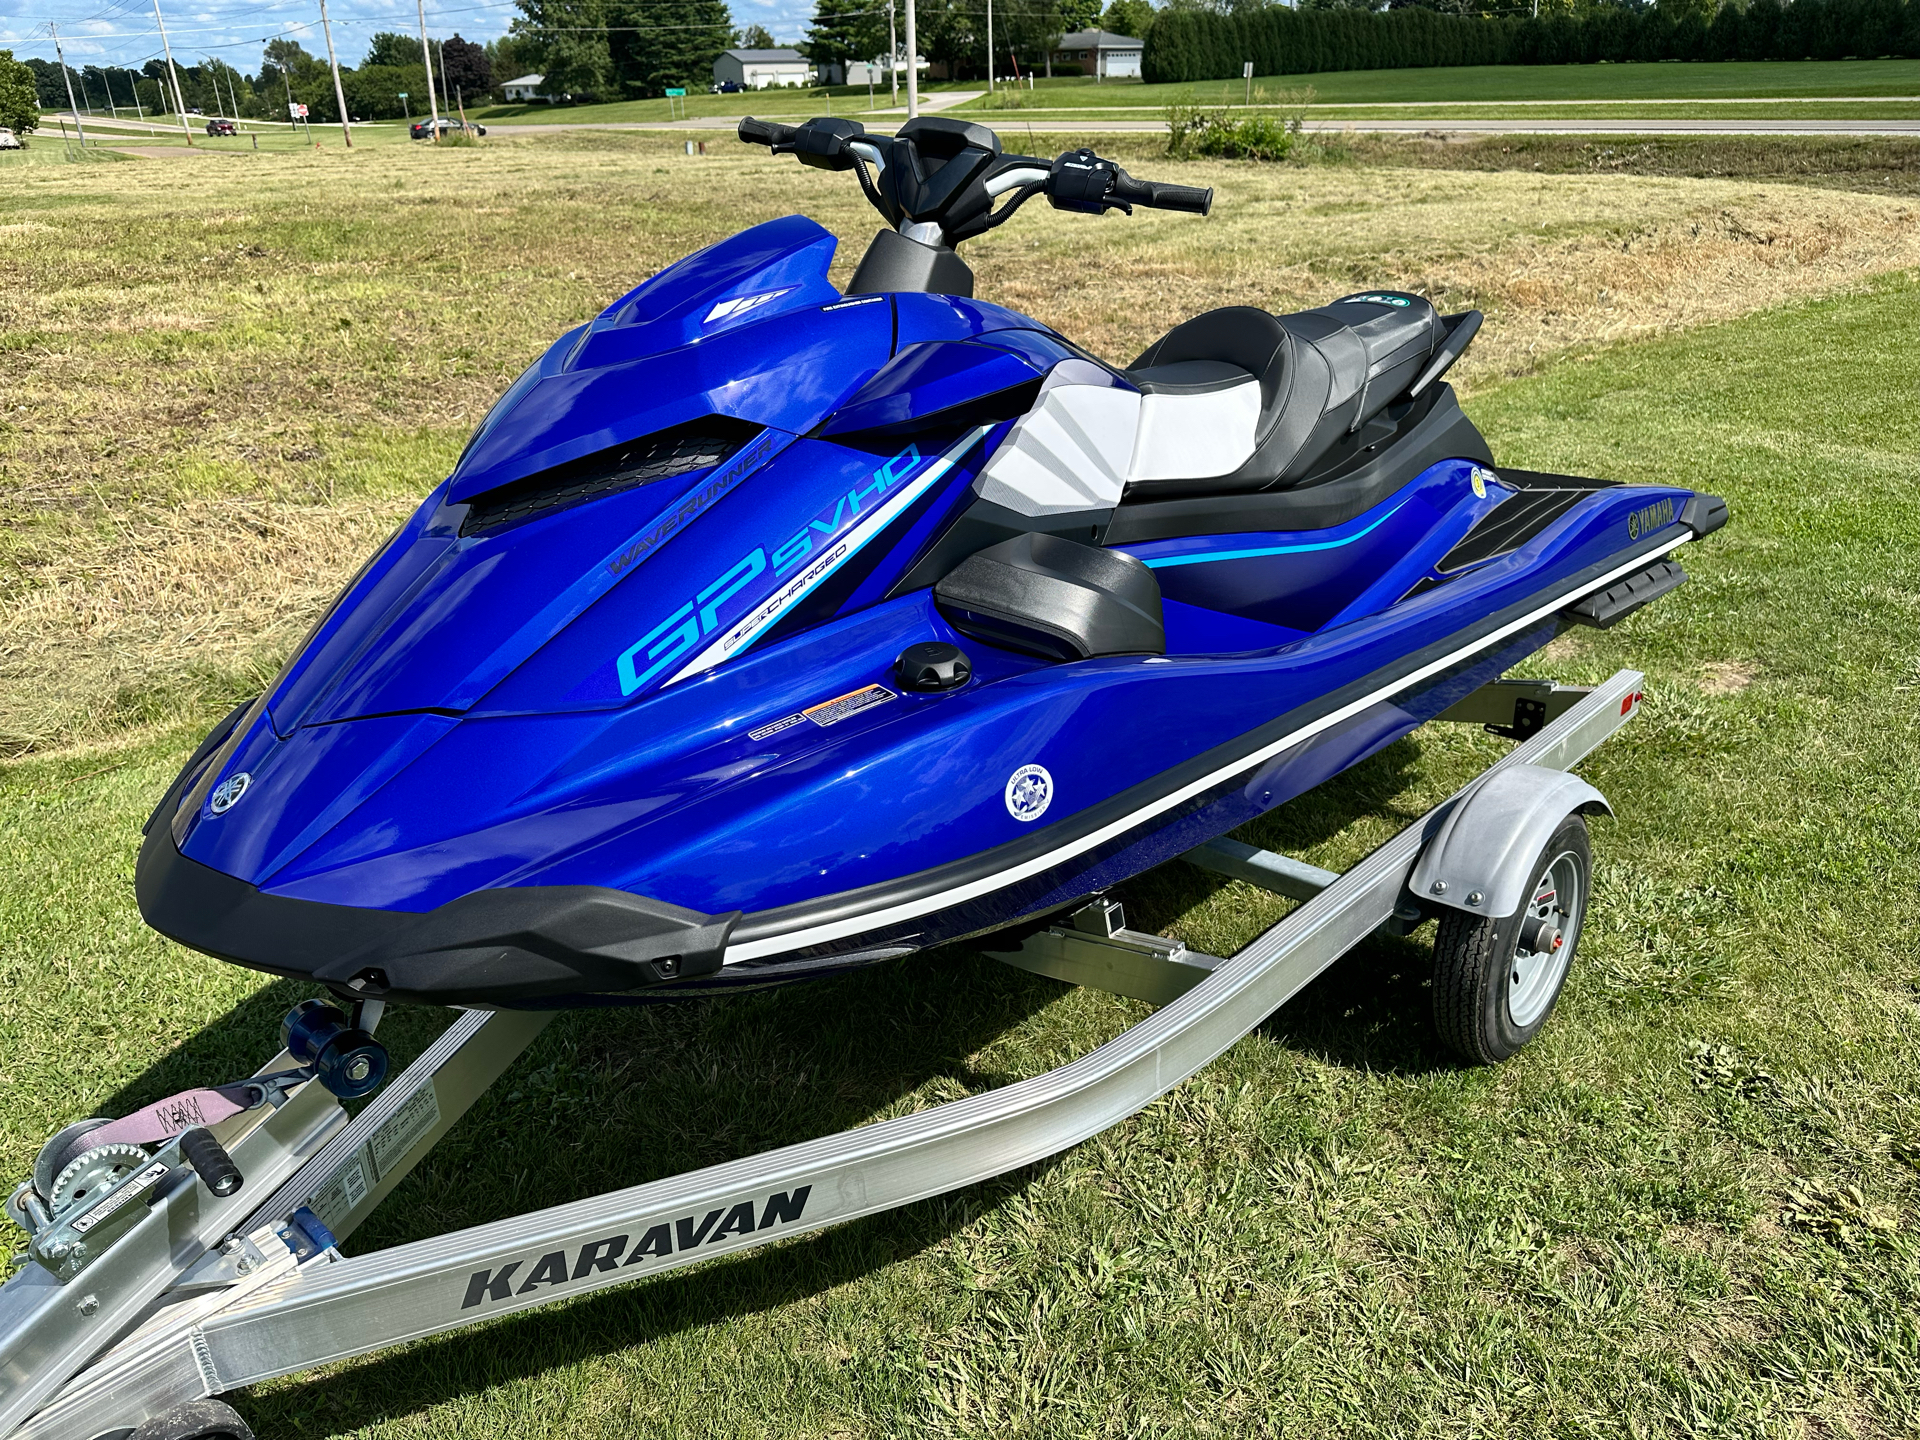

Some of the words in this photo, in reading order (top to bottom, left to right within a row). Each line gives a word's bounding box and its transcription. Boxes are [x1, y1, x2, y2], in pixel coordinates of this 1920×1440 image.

[609, 439, 773, 575] WAVERUNNER
[1637, 498, 1673, 535] YAMAHA
[616, 547, 766, 697] GP
[771, 442, 921, 578] SVHO
[724, 543, 847, 652] SUPERCHARGED
[1011, 768, 1028, 784] ULTRA
[460, 1184, 813, 1310] KARAVAN
